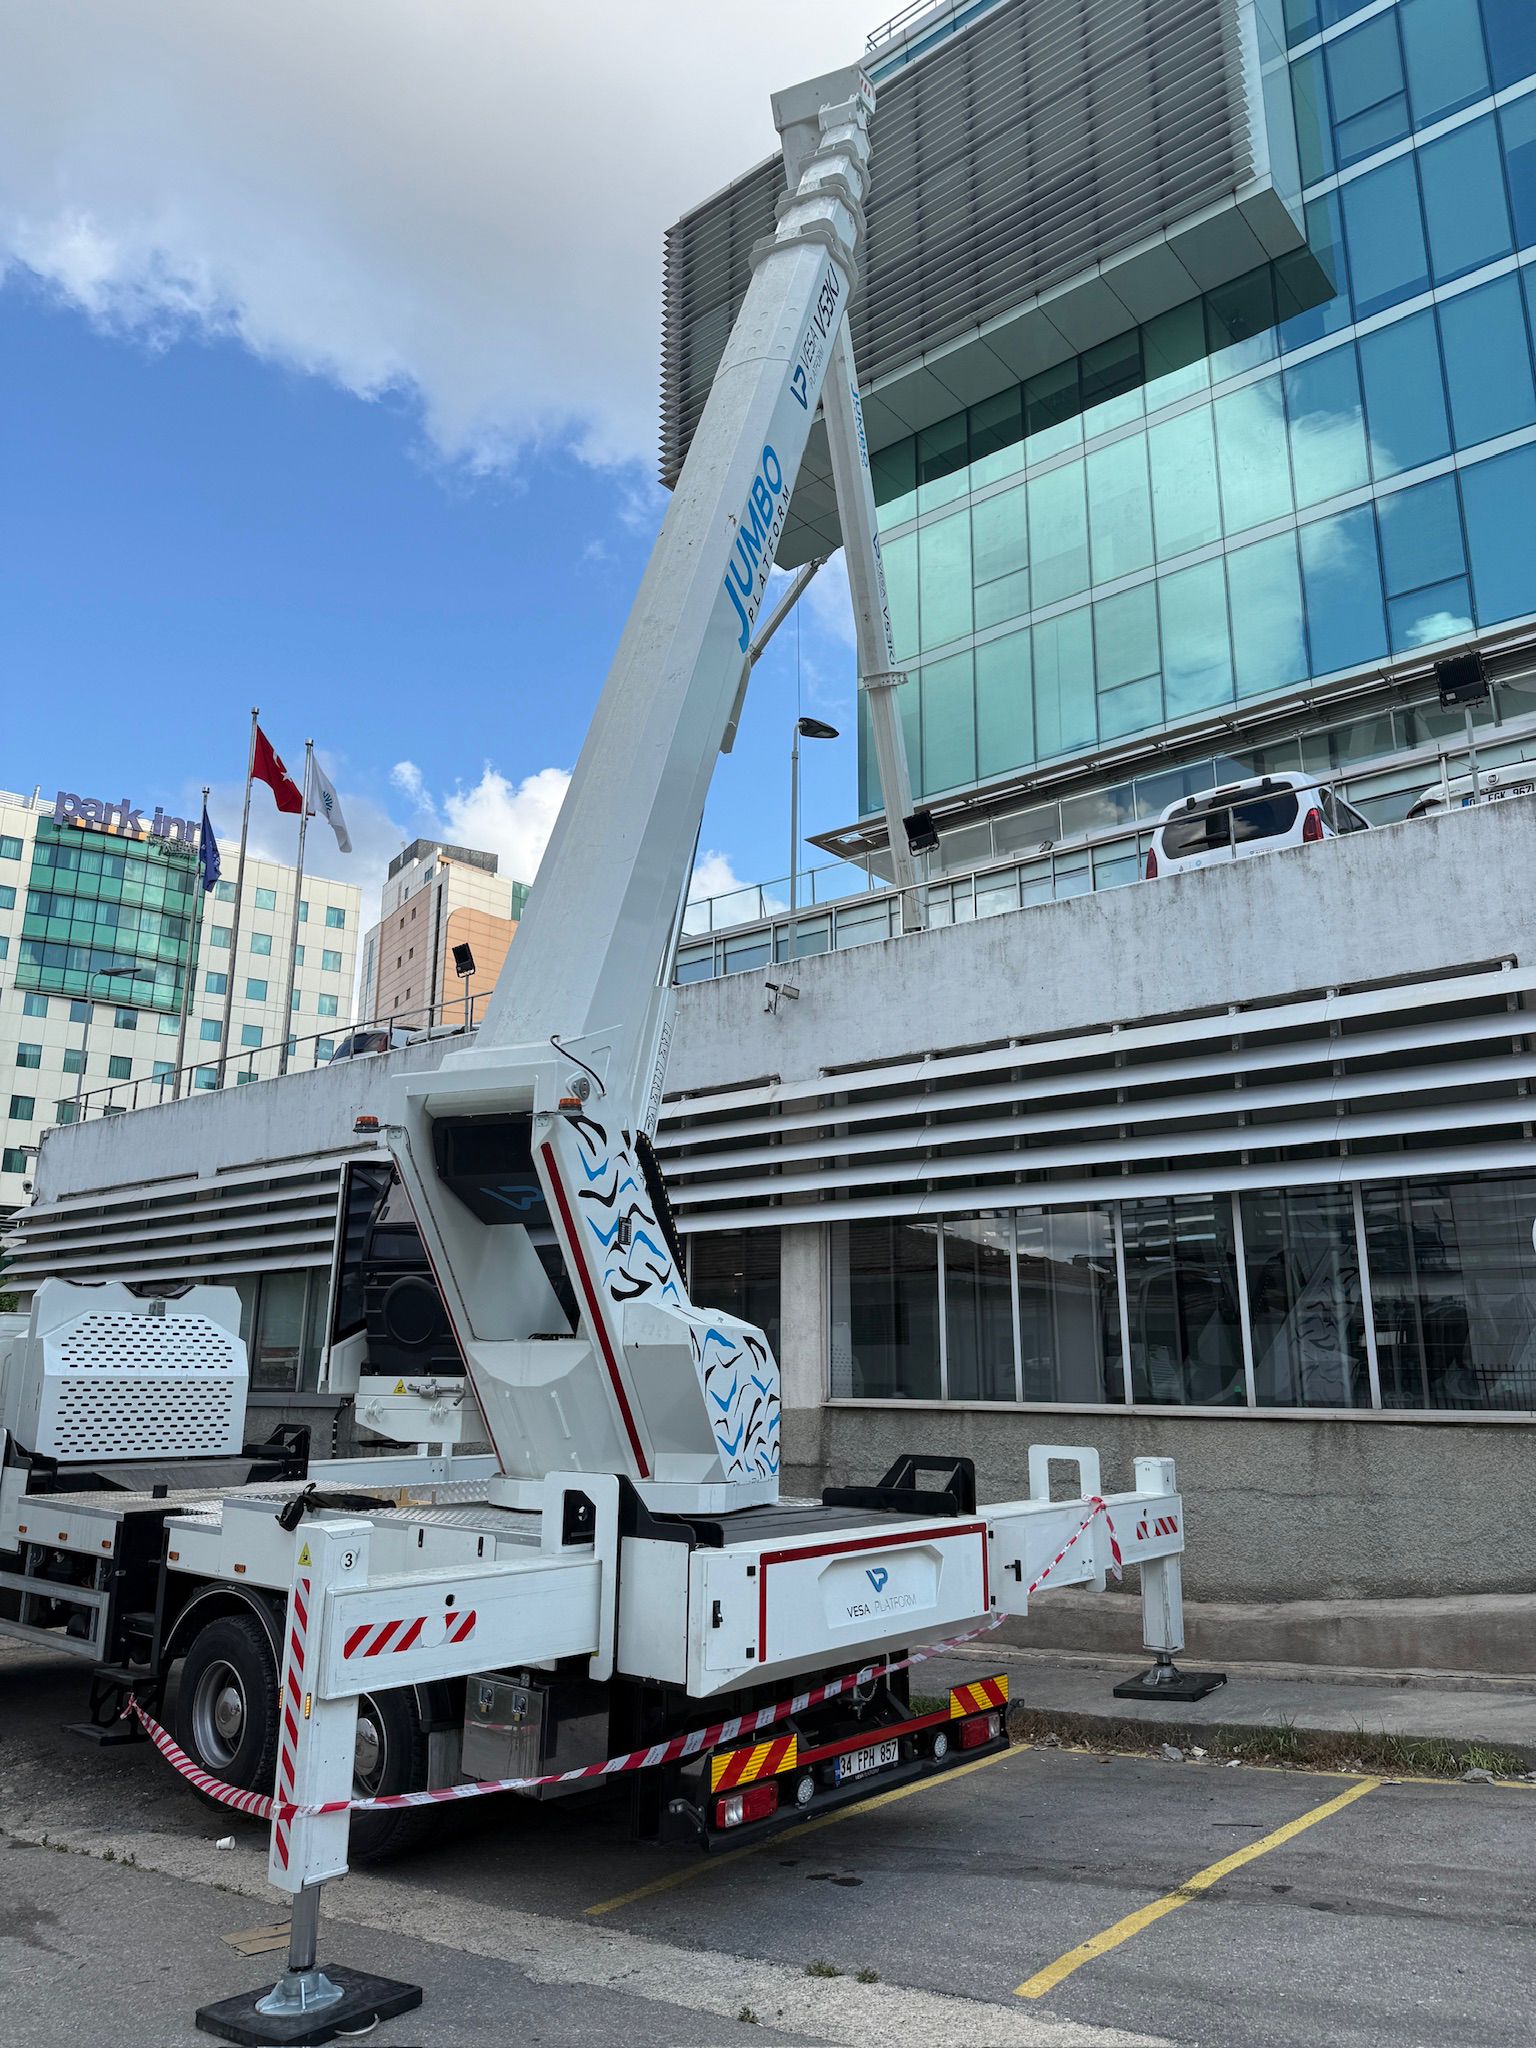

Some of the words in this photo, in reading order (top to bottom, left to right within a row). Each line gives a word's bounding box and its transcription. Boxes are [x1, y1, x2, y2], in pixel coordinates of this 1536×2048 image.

[800, 325, 819, 370] VESA
[724, 444, 783, 654] JUMBO
[748, 484, 790, 624] PLATFORM
[53, 790, 145, 832] park
[344, 1552, 353, 1567] 3
[846, 1604, 871, 1618] VESA
[874, 1594, 917, 1613] PLATFORM
[840, 1755, 851, 1775] 34
[858, 1748, 874, 1770] FPH
[881, 1741, 896, 1763] 857
